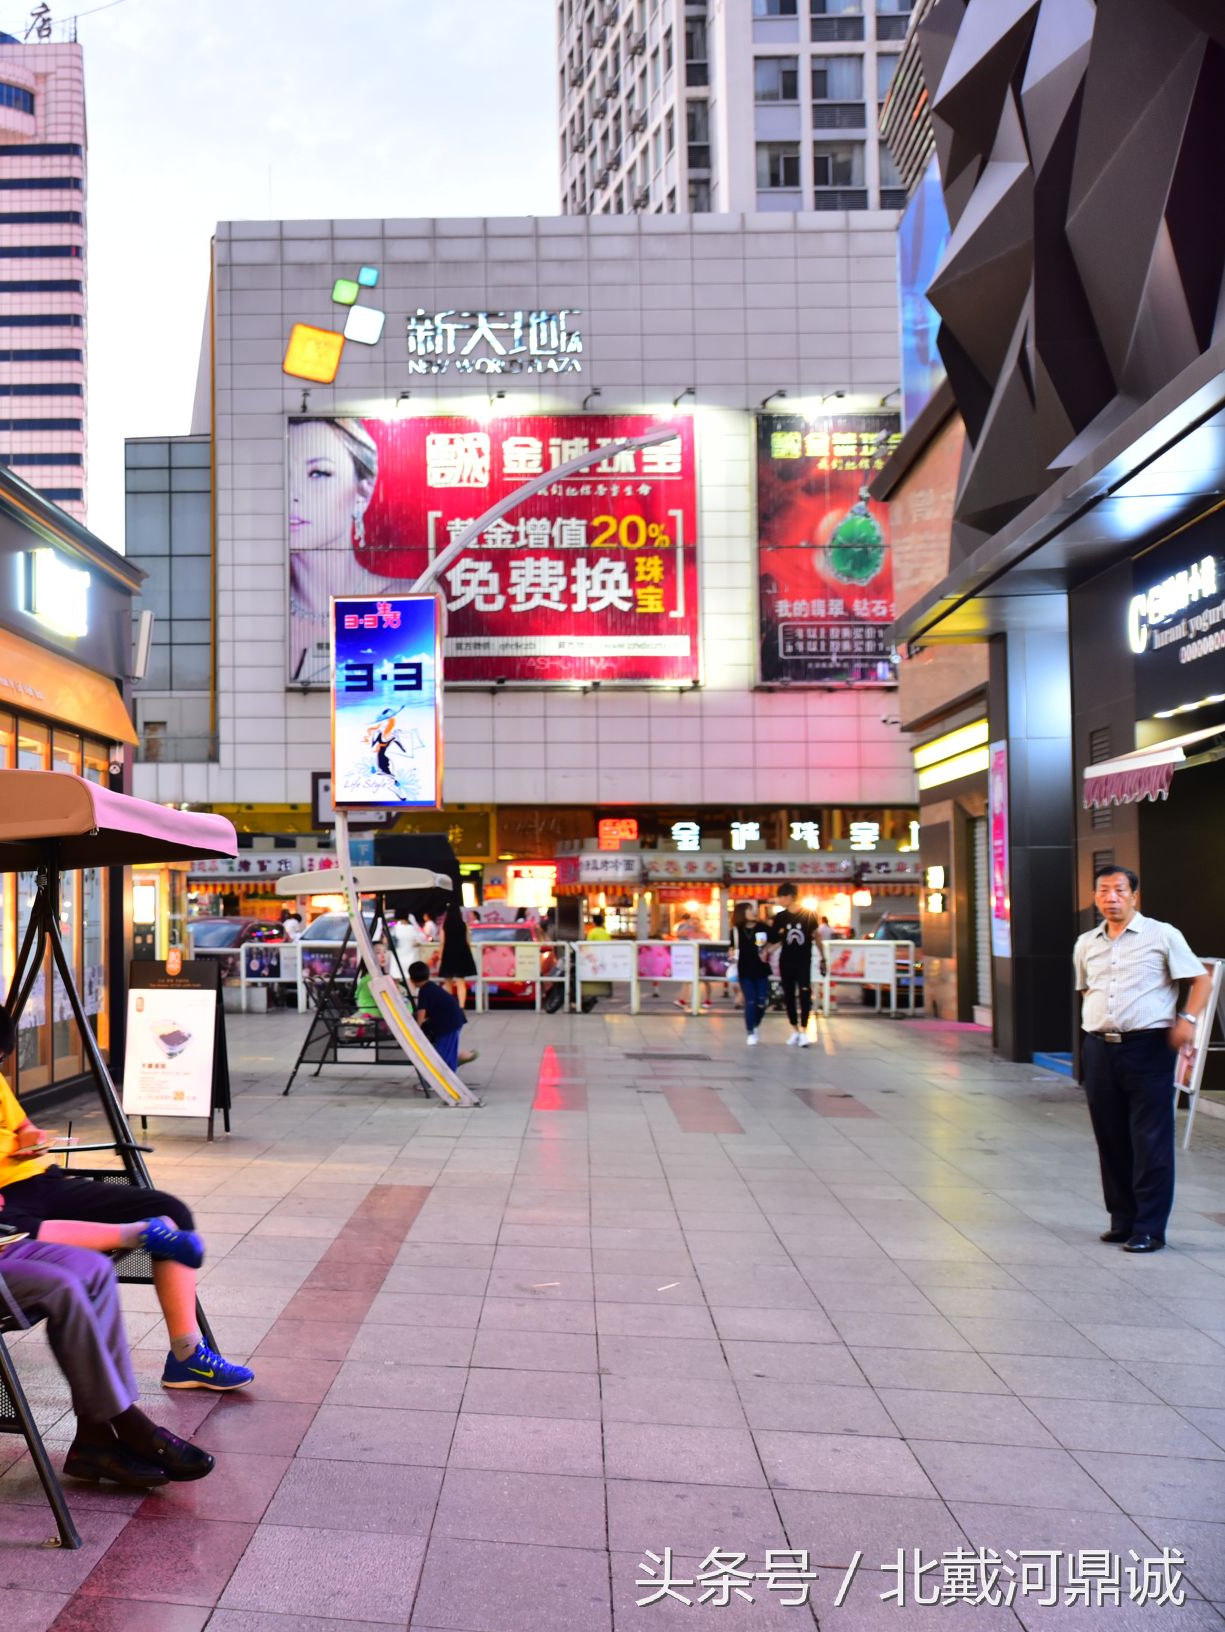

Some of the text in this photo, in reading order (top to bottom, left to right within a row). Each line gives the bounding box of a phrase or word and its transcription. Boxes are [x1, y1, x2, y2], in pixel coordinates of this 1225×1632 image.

[446, 557, 633, 613] 免费换
[635, 555, 665, 614] 珠宝
